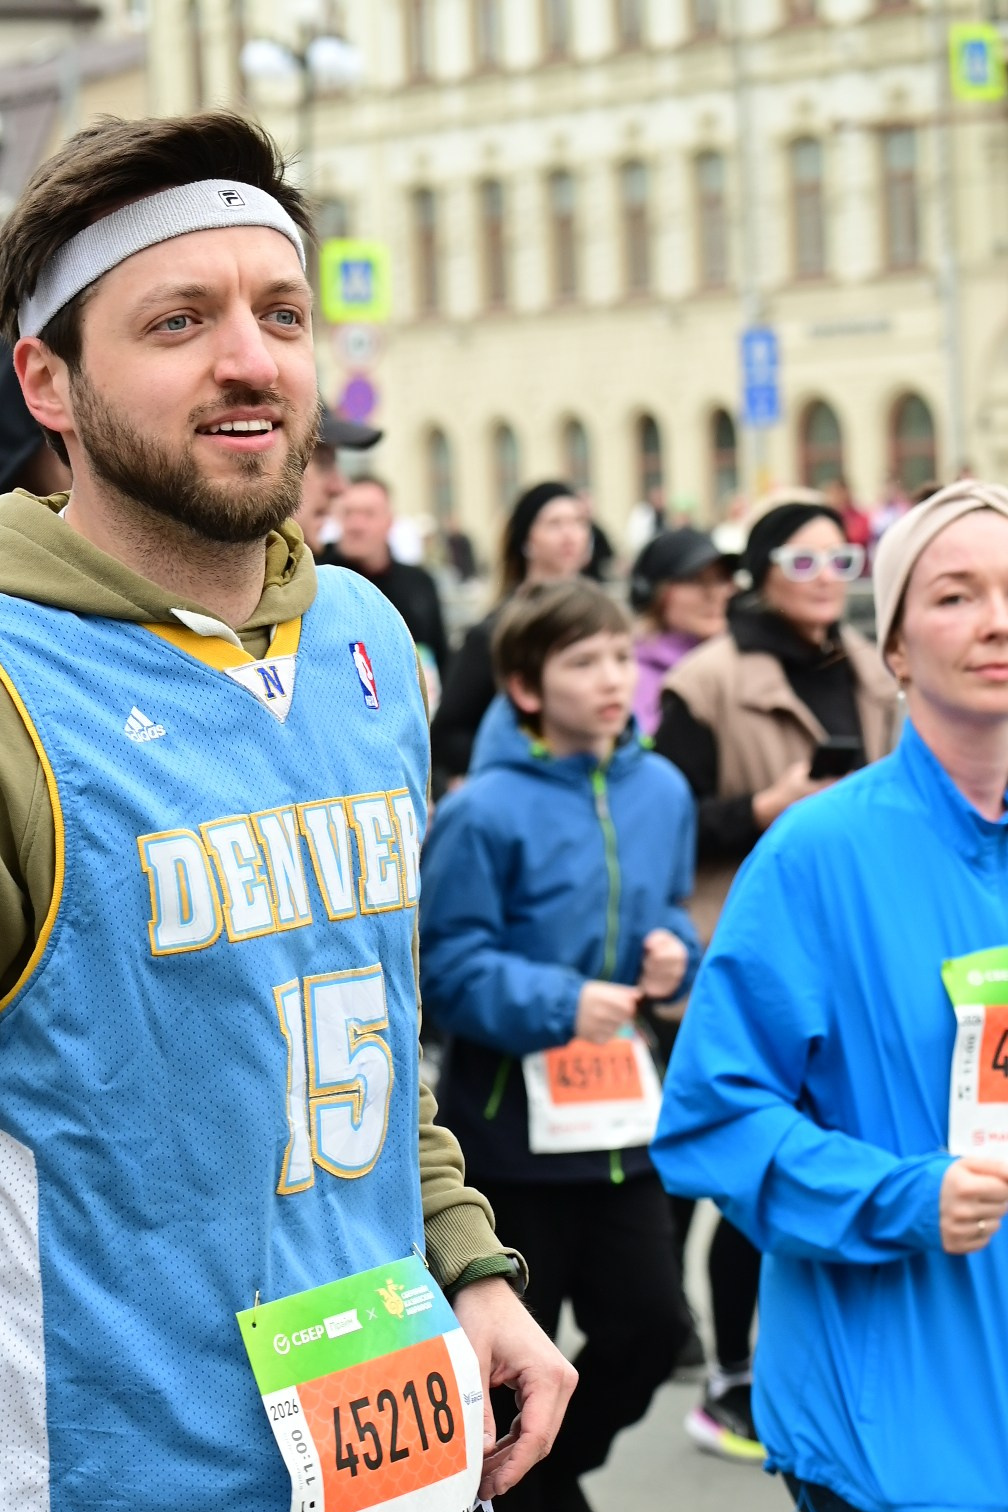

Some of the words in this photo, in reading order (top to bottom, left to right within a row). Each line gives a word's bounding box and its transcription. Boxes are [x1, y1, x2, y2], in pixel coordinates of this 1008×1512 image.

[256, 665, 286, 699] N
[124, 724, 166, 743] adidas
[137, 787, 421, 957] DENVER
[272, 962, 394, 1196] 15
[291, 1324, 324, 1346] СБЕР
[270, 1398, 299, 1421] 2026
[333, 1371, 455, 1478] 45218
[291, 1429, 315, 1486] 11:00
